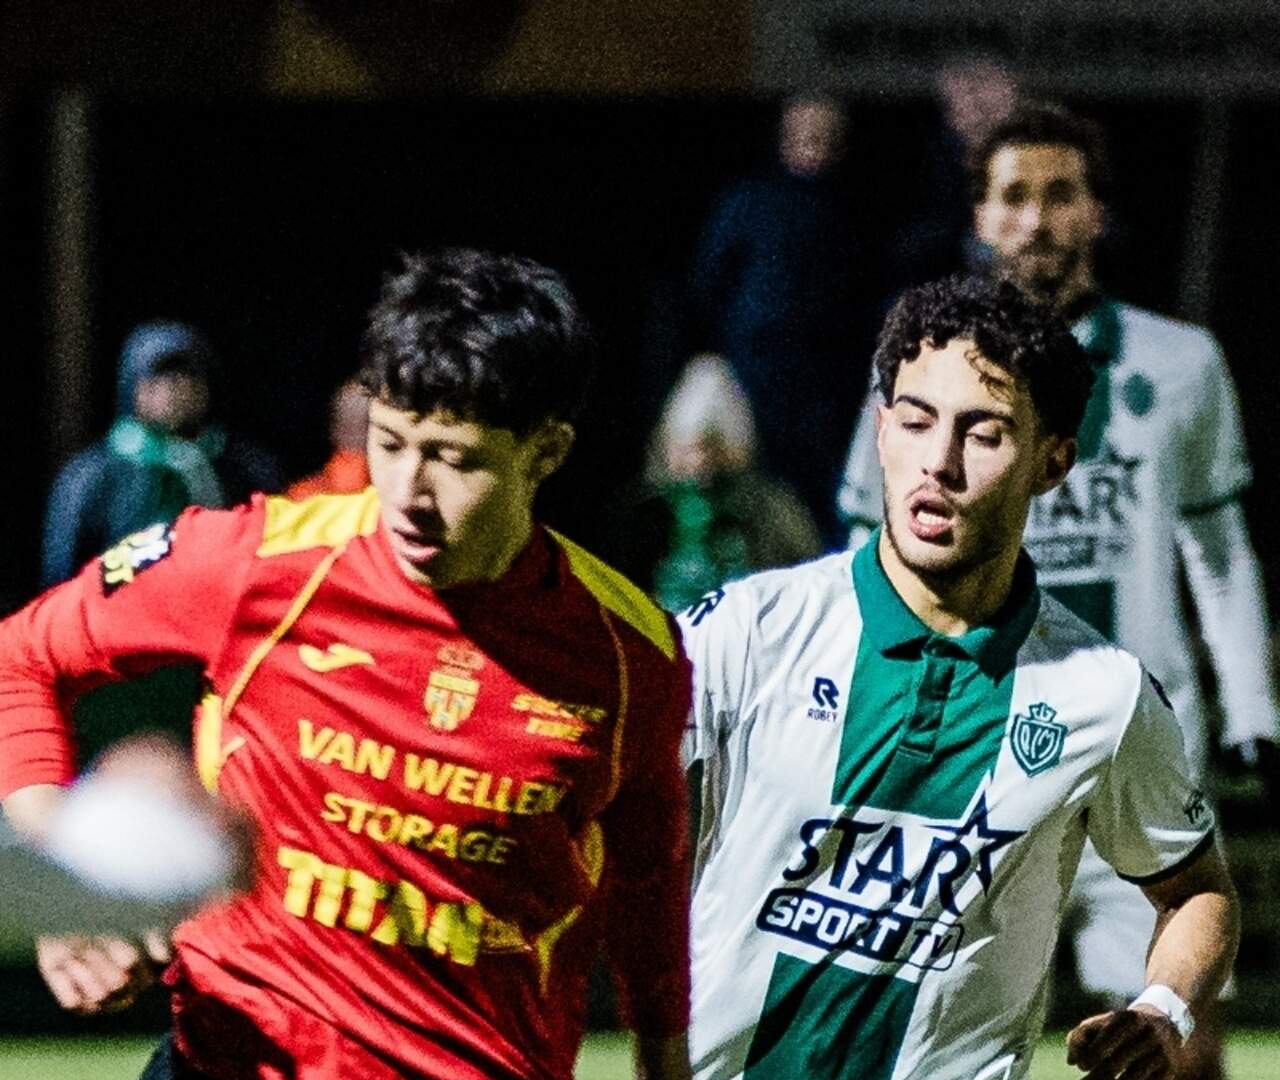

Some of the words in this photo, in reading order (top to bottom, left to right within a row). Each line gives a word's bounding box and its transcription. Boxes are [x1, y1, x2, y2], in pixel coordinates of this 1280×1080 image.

[298, 718, 396, 780] VAN
[404, 752, 567, 815] WELLEN
[320, 791, 518, 865] STORAGE
[782, 817, 964, 917] STAR
[277, 846, 485, 967] TITAN
[765, 895, 901, 952] SPORT
[913, 926, 956, 960] TV
